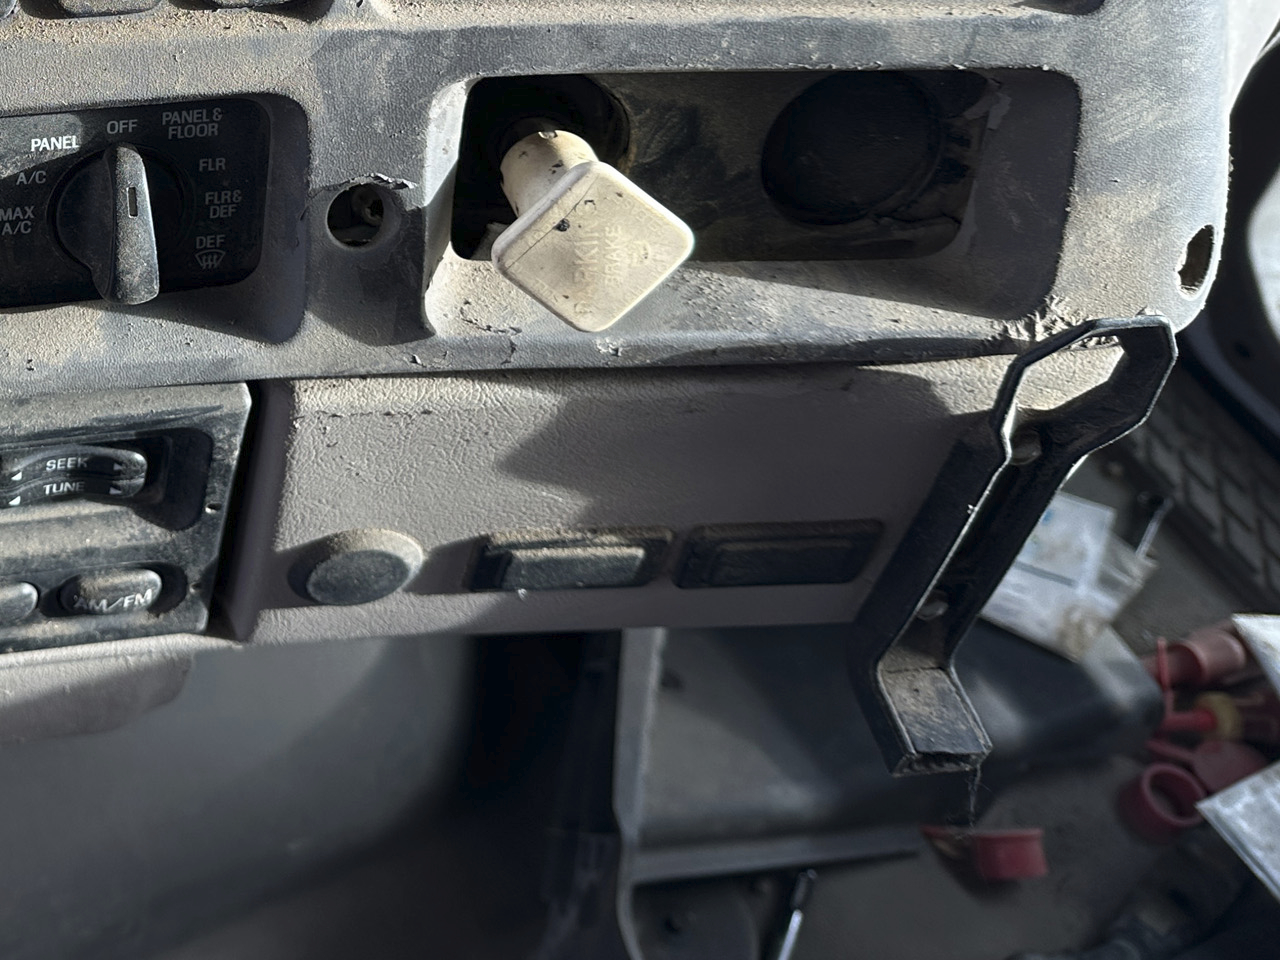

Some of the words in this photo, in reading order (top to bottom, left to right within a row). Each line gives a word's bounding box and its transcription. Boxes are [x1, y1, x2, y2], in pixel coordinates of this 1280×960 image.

[162, 108, 210, 126] PANEL
[212, 107, 223, 121] &
[106, 119, 138, 134] OFF
[168, 123, 219, 140] FLOOR
[31, 135, 79, 152] PANEL
[199, 158, 226, 172] FLR
[16, 171, 47, 185] A/C
[209, 205, 237, 218] DEF
[2, 221, 32, 236] A/C
[196, 234, 226, 249] DEF
[46, 456, 88, 472] SEEK
[43, 480, 86, 496] TUNE
[73, 588, 153, 612] AM/FM
